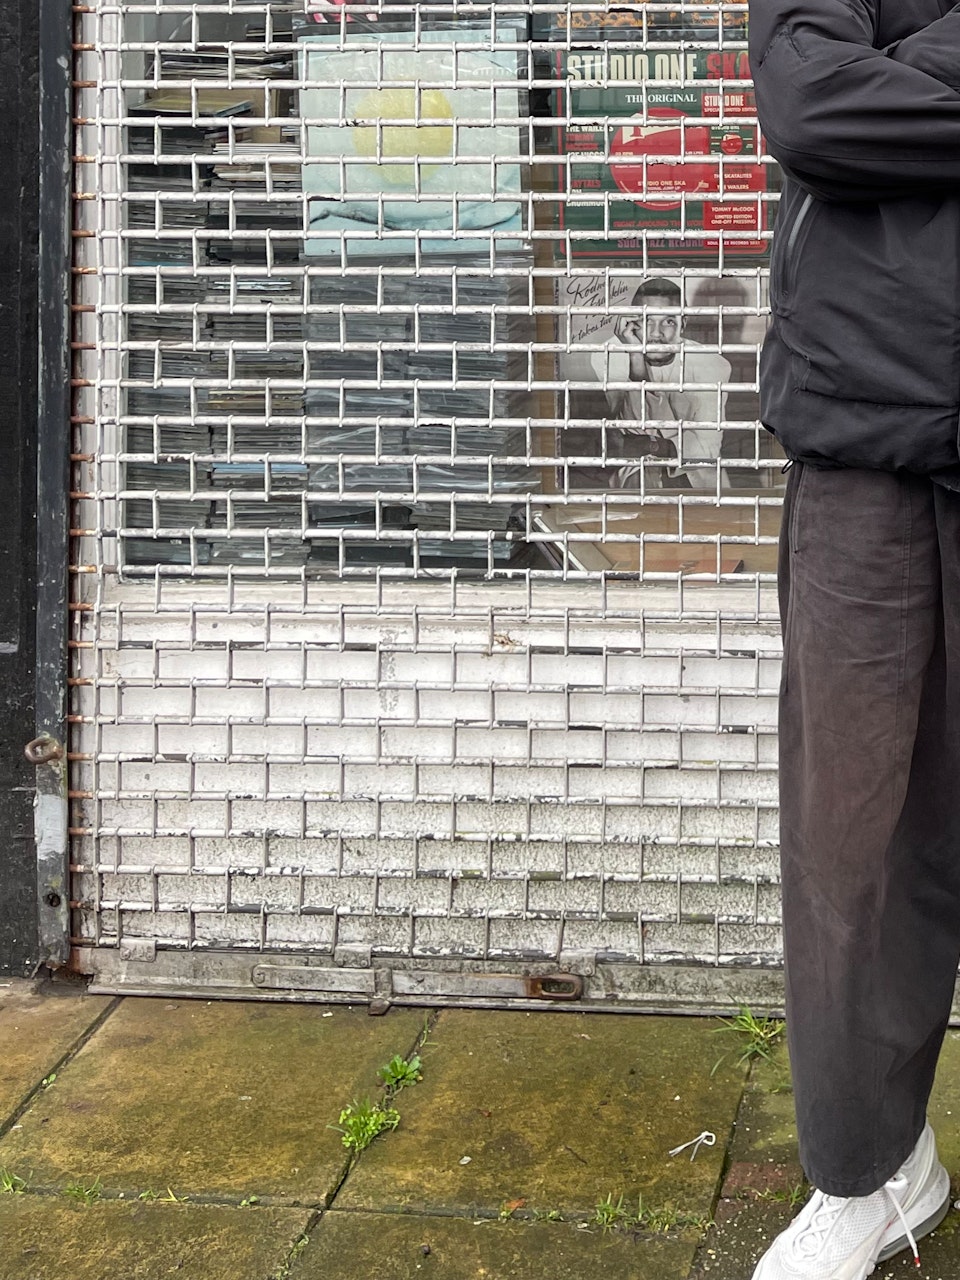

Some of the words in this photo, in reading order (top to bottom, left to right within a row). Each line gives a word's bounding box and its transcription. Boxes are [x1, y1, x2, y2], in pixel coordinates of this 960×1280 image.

[566, 54, 649, 81] STUDIO
[654, 53, 698, 81] ONE
[648, 93, 698, 103] ORIGINAL
[581, 125, 614, 133] WAILES
